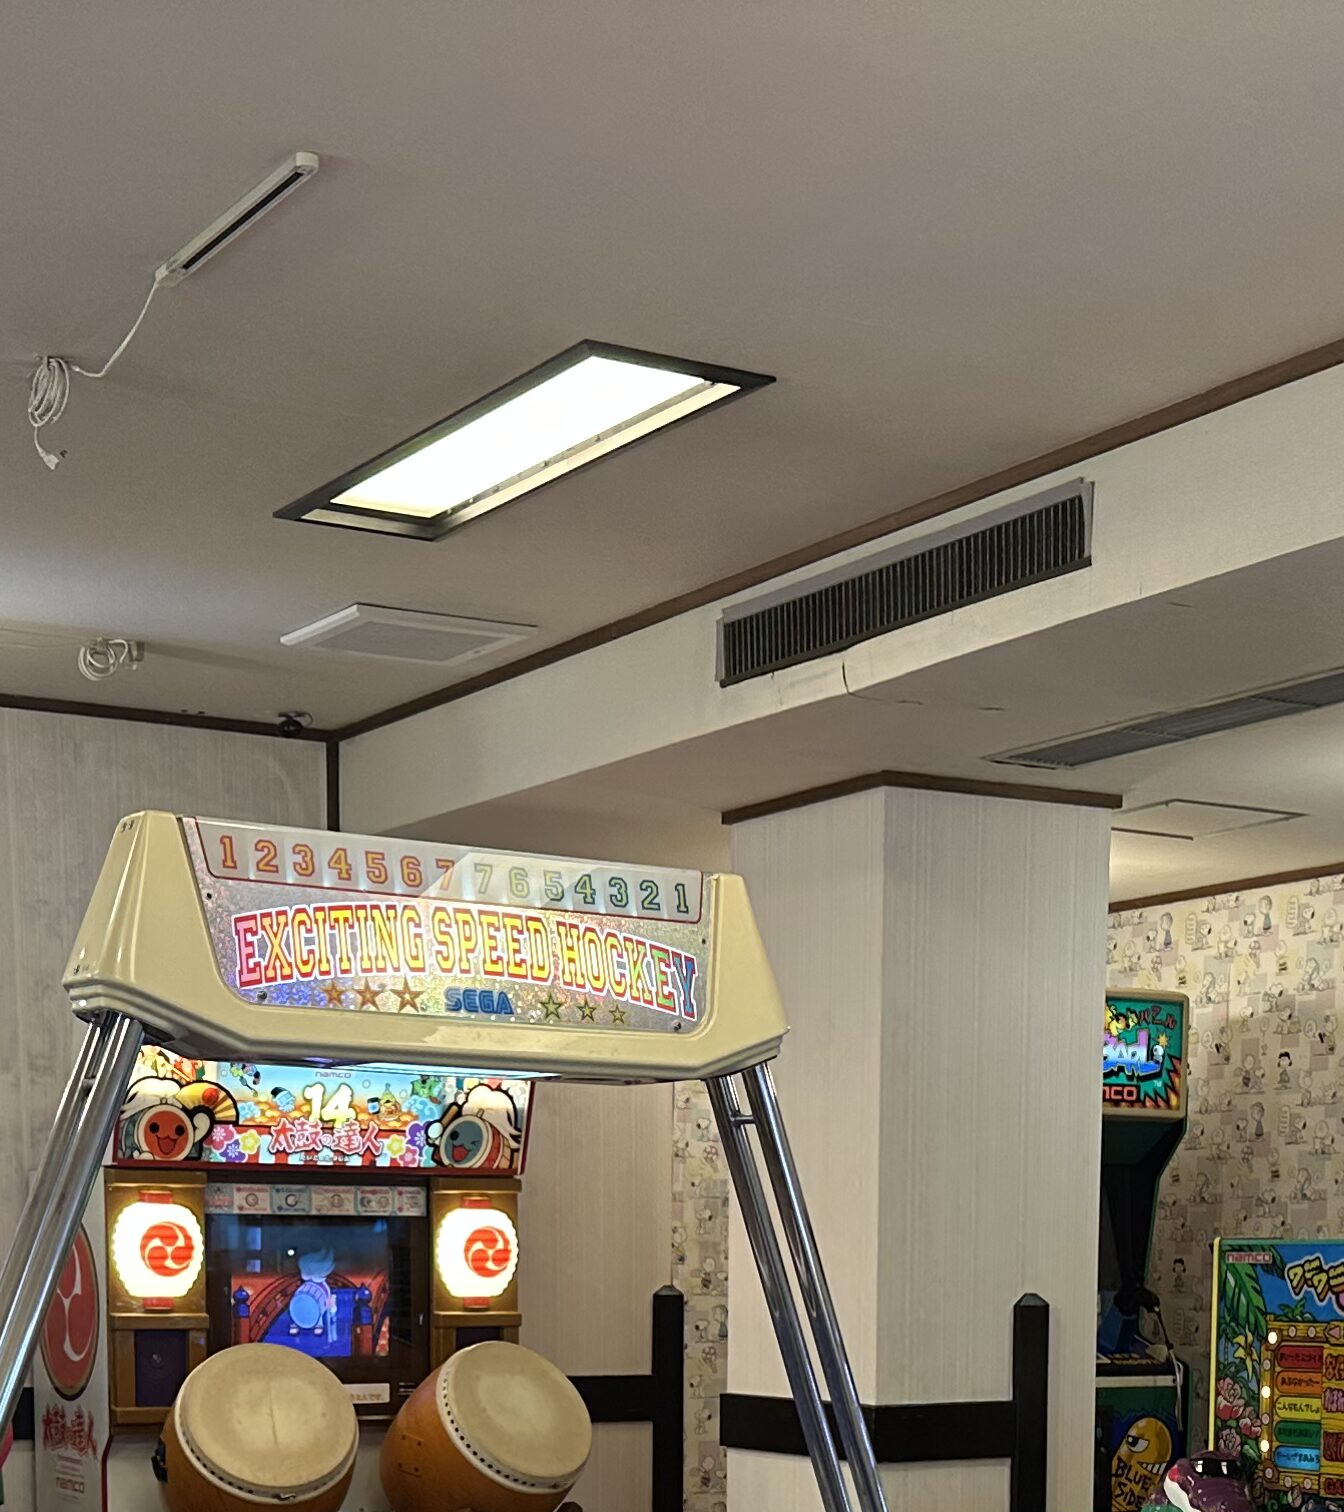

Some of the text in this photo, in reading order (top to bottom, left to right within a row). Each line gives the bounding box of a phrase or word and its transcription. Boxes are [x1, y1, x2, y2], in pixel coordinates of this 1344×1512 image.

[219, 835, 689, 914] 1 2 3 4 5 6 7 7 6 5 4 3 2 1
[233, 904, 697, 1019] EXCITING SPEED HOCKEY
[445, 988, 514, 1015] SEGA
[315, 1071, 352, 1079] namco
[304, 1082, 357, 1129] 14
[270, 1118, 383, 1156] 太鼓の達人
[1225, 1252, 1273, 1264] namco
